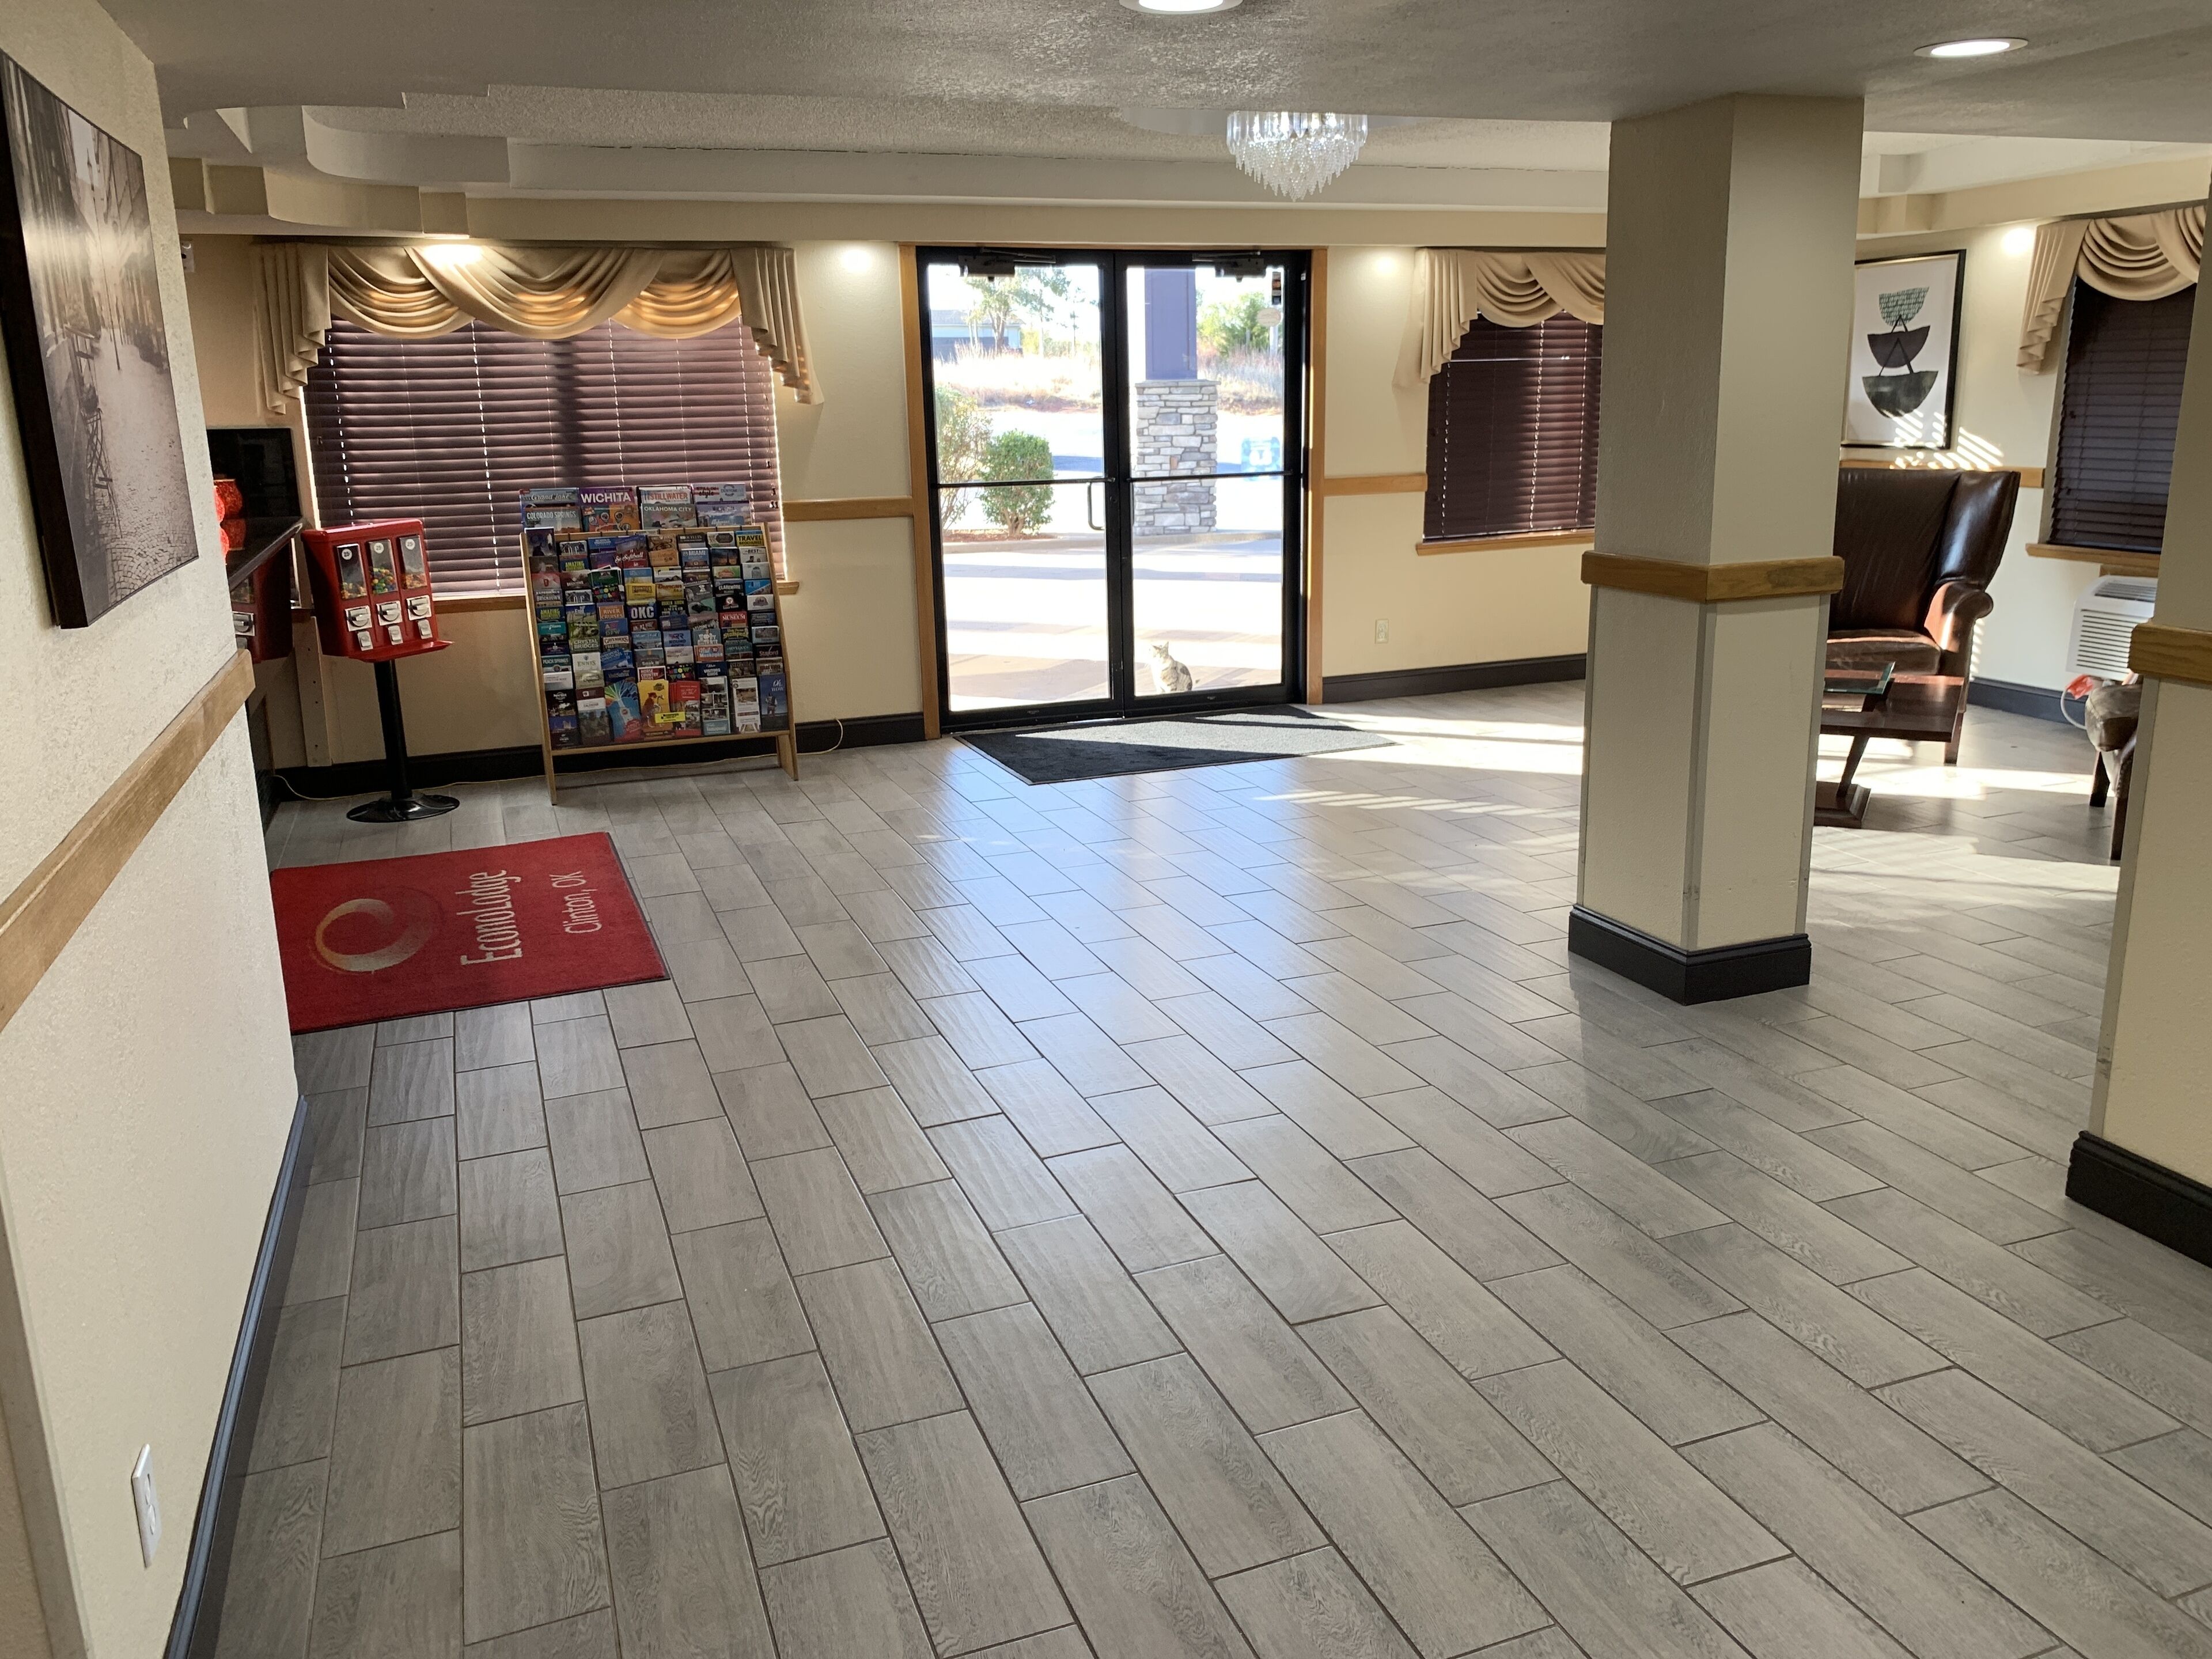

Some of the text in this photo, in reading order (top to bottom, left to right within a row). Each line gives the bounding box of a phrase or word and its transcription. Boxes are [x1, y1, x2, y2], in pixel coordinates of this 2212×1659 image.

[581, 492, 631, 503] WICHITA
[527, 512, 554, 520] COLORADO
[631, 606, 654, 619] OKC
[549, 870, 602, 933] Clinton, OK
[456, 870, 522, 965] EconoLodge
